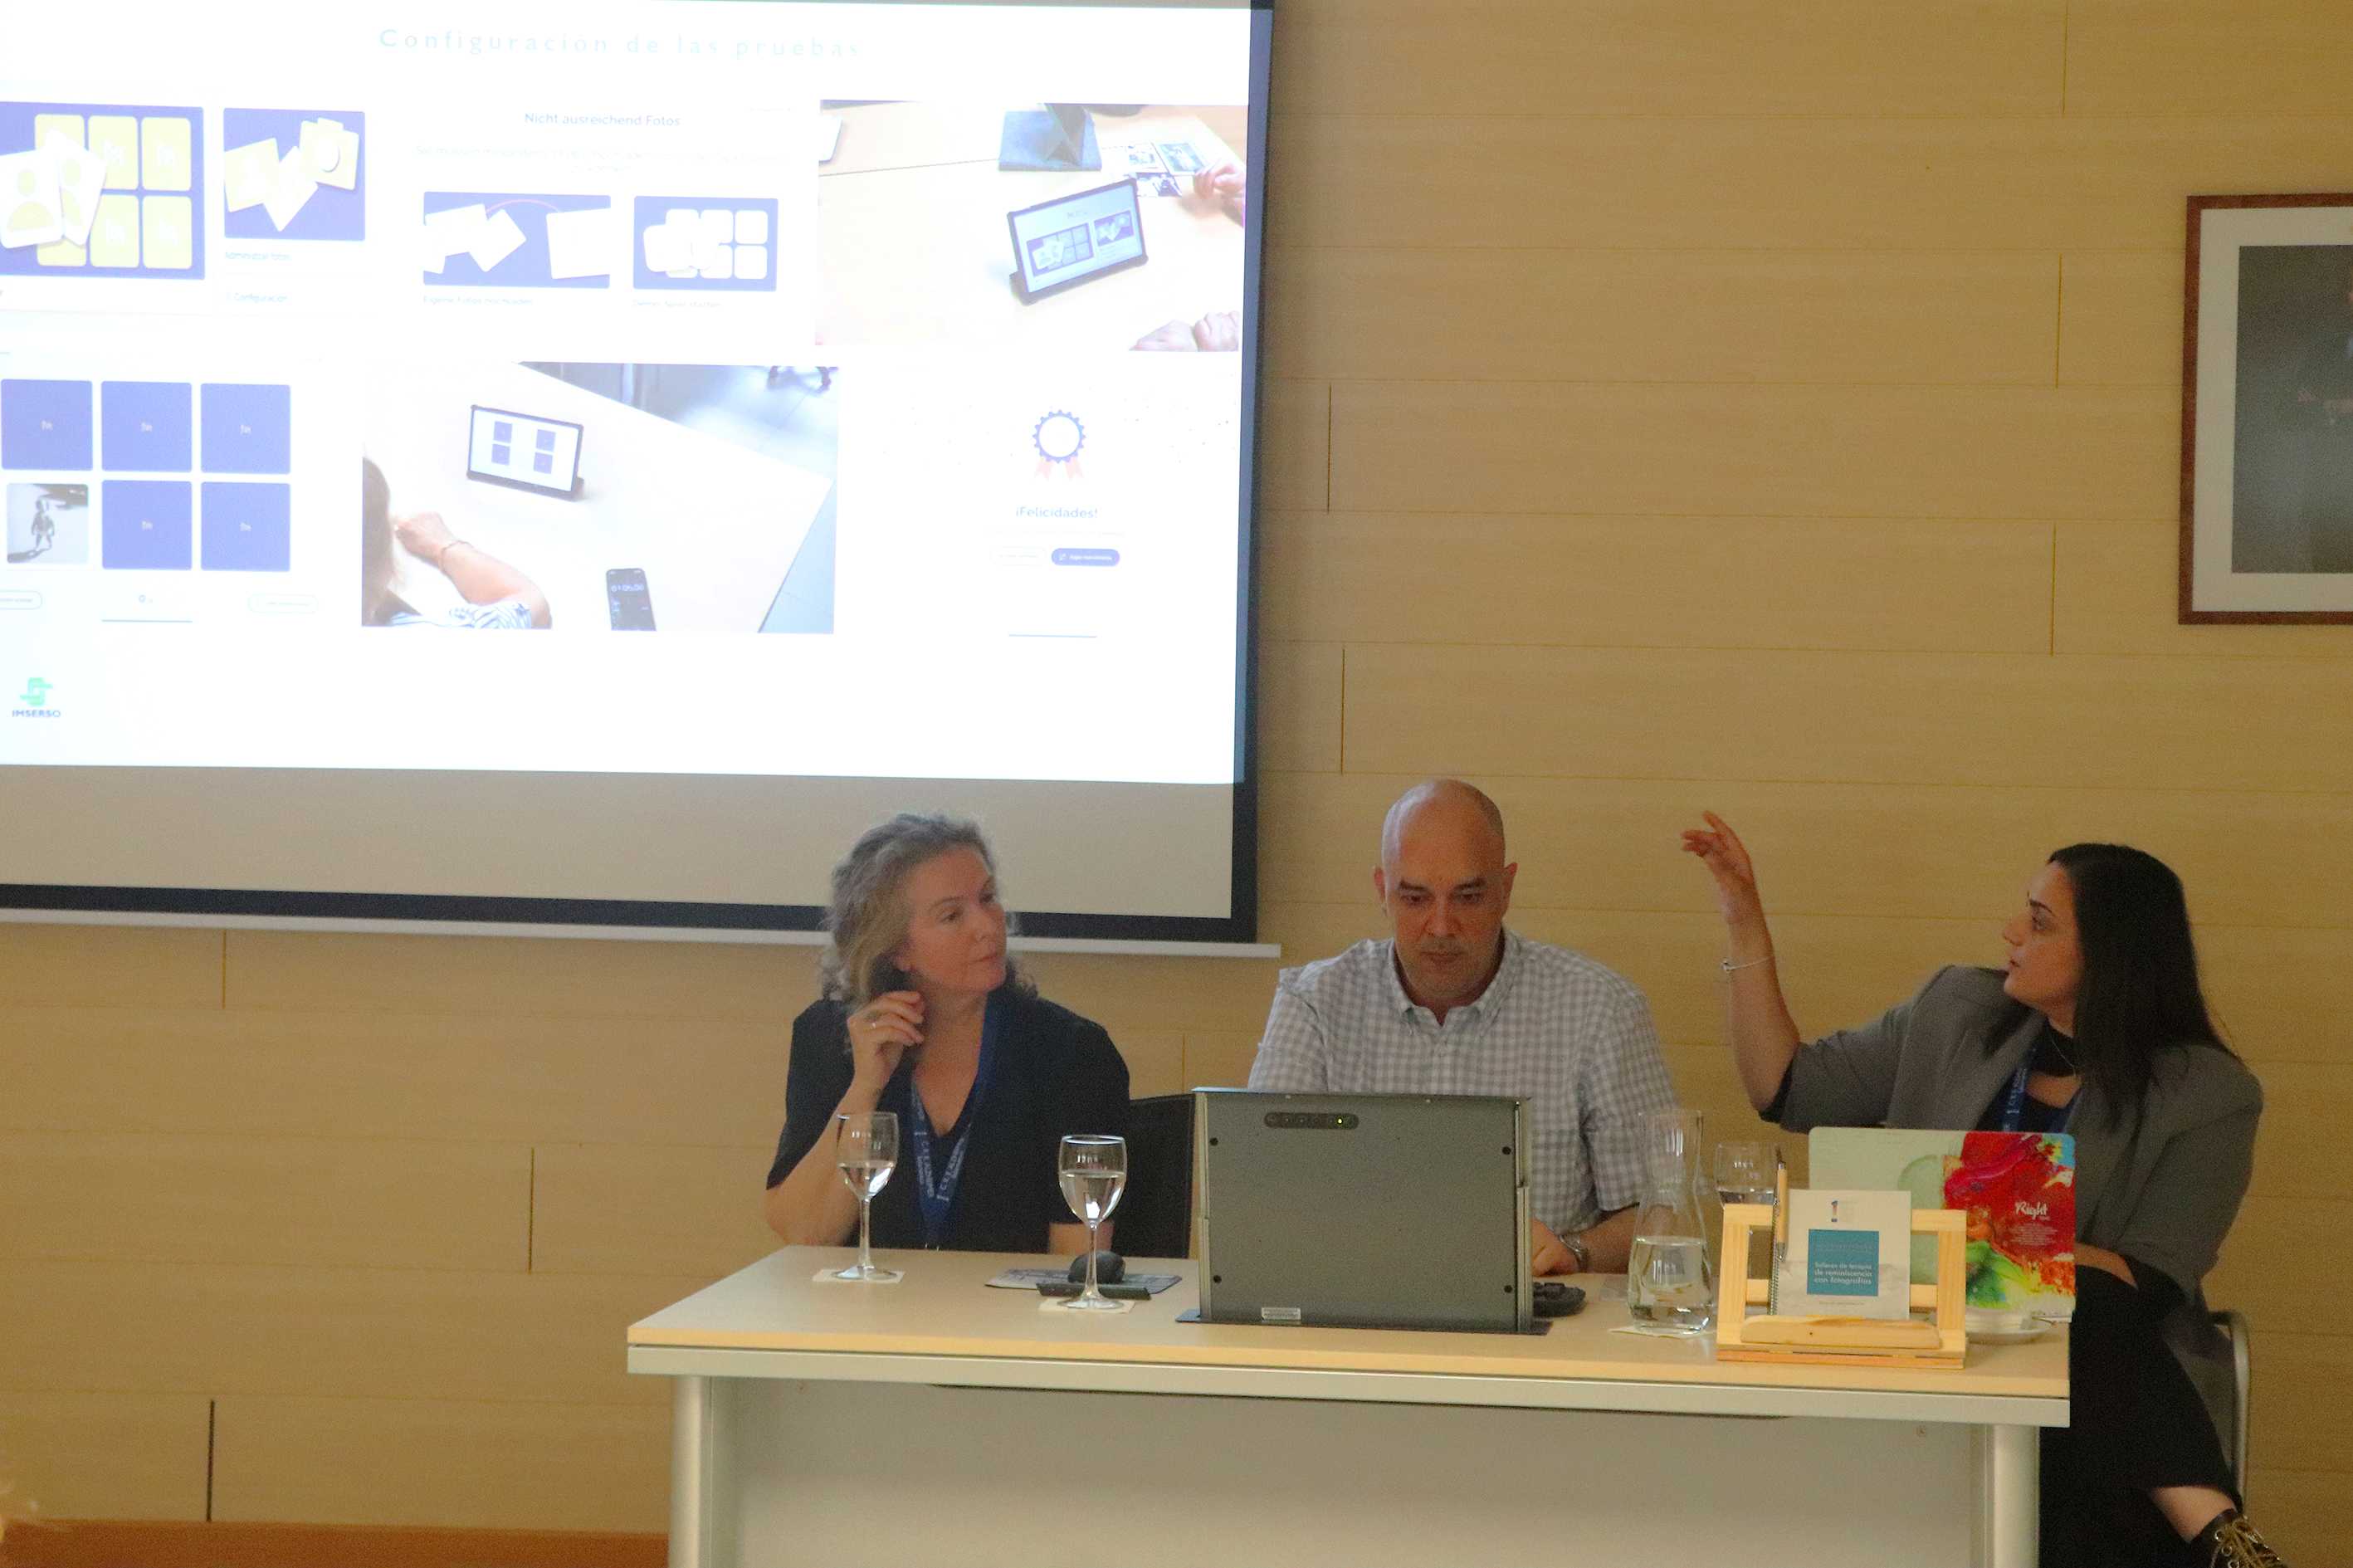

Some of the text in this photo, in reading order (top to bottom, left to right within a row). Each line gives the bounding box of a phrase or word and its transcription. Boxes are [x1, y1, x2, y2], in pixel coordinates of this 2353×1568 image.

[378, 28, 859, 60] Configuración de las pruebas
[525, 112, 681, 126] Nicht ausreichend Fotos
[1015, 505, 1098, 518] ¡Felicidades!
[12, 709, 61, 718] IMSERSO
[2014, 1200, 2048, 1220] Right
